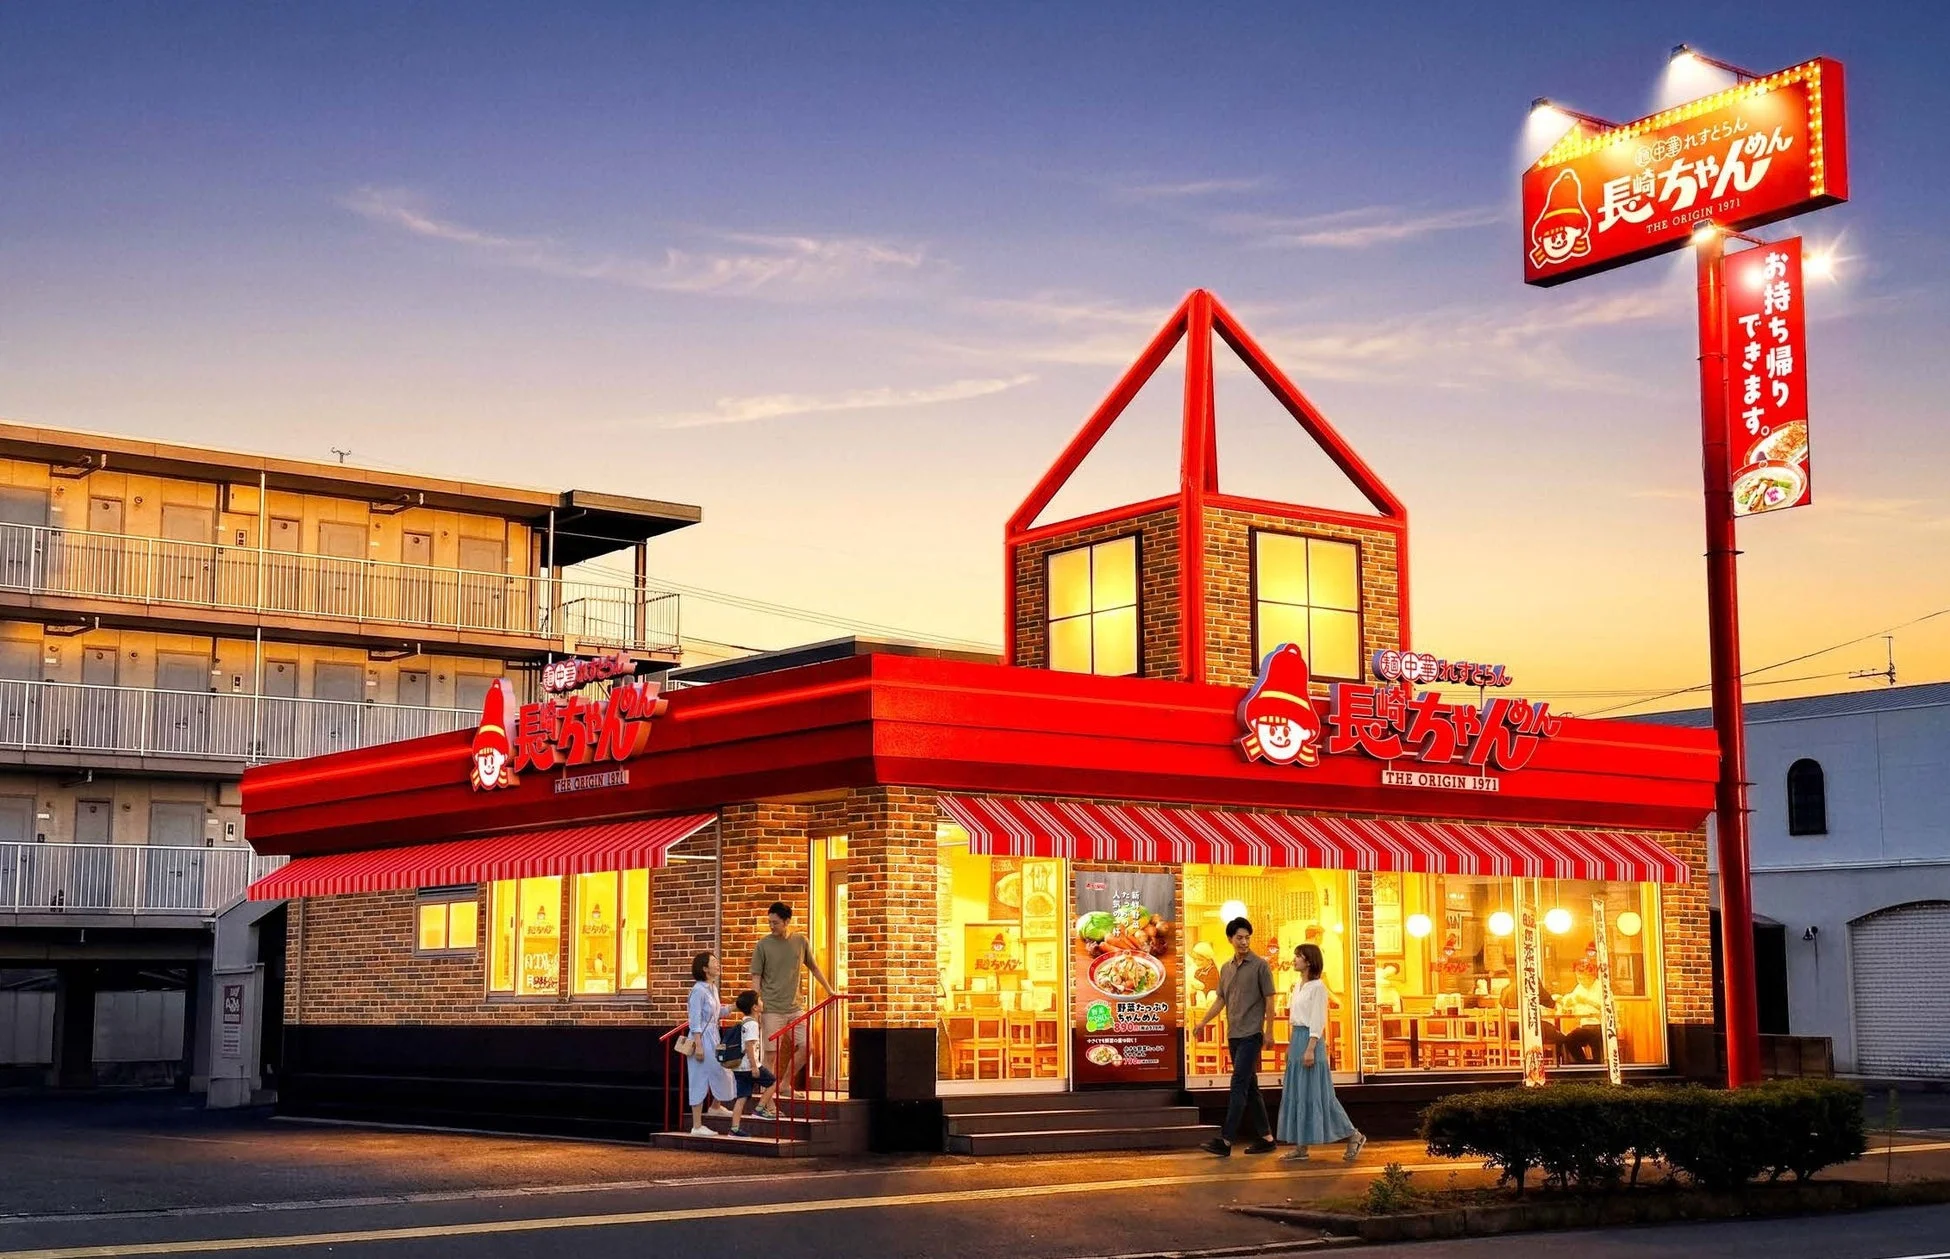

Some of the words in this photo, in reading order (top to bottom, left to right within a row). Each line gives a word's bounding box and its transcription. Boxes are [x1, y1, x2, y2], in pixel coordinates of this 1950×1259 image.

[1597, 126, 1794, 233] 長崎ちゃんめん
[1646, 219, 1669, 234] THE
[1672, 206, 1714, 228] ORIGIN
[1718, 198, 1742, 213] 1971
[1763, 252, 1793, 408] お持ち帰り
[1738, 314, 1771, 437] できます。
[1380, 649, 1514, 686] 麺中華れすとらん
[514, 684, 658, 774] 長崎ちゃんめん
[1327, 683, 1563, 771] 長崎ちゃんめん
[555, 779, 571, 793] THE
[574, 775, 604, 790] ORIGIN
[607, 771, 624, 786] 1971
[1386, 772, 1413, 786] THE
[1418, 774, 1467, 789] ORIGIN
[1472, 776, 1498, 791] 1971
[1116, 1002, 1168, 1013] 野菜たっぷり
[1118, 1013, 1160, 1022] ちゃんめん
